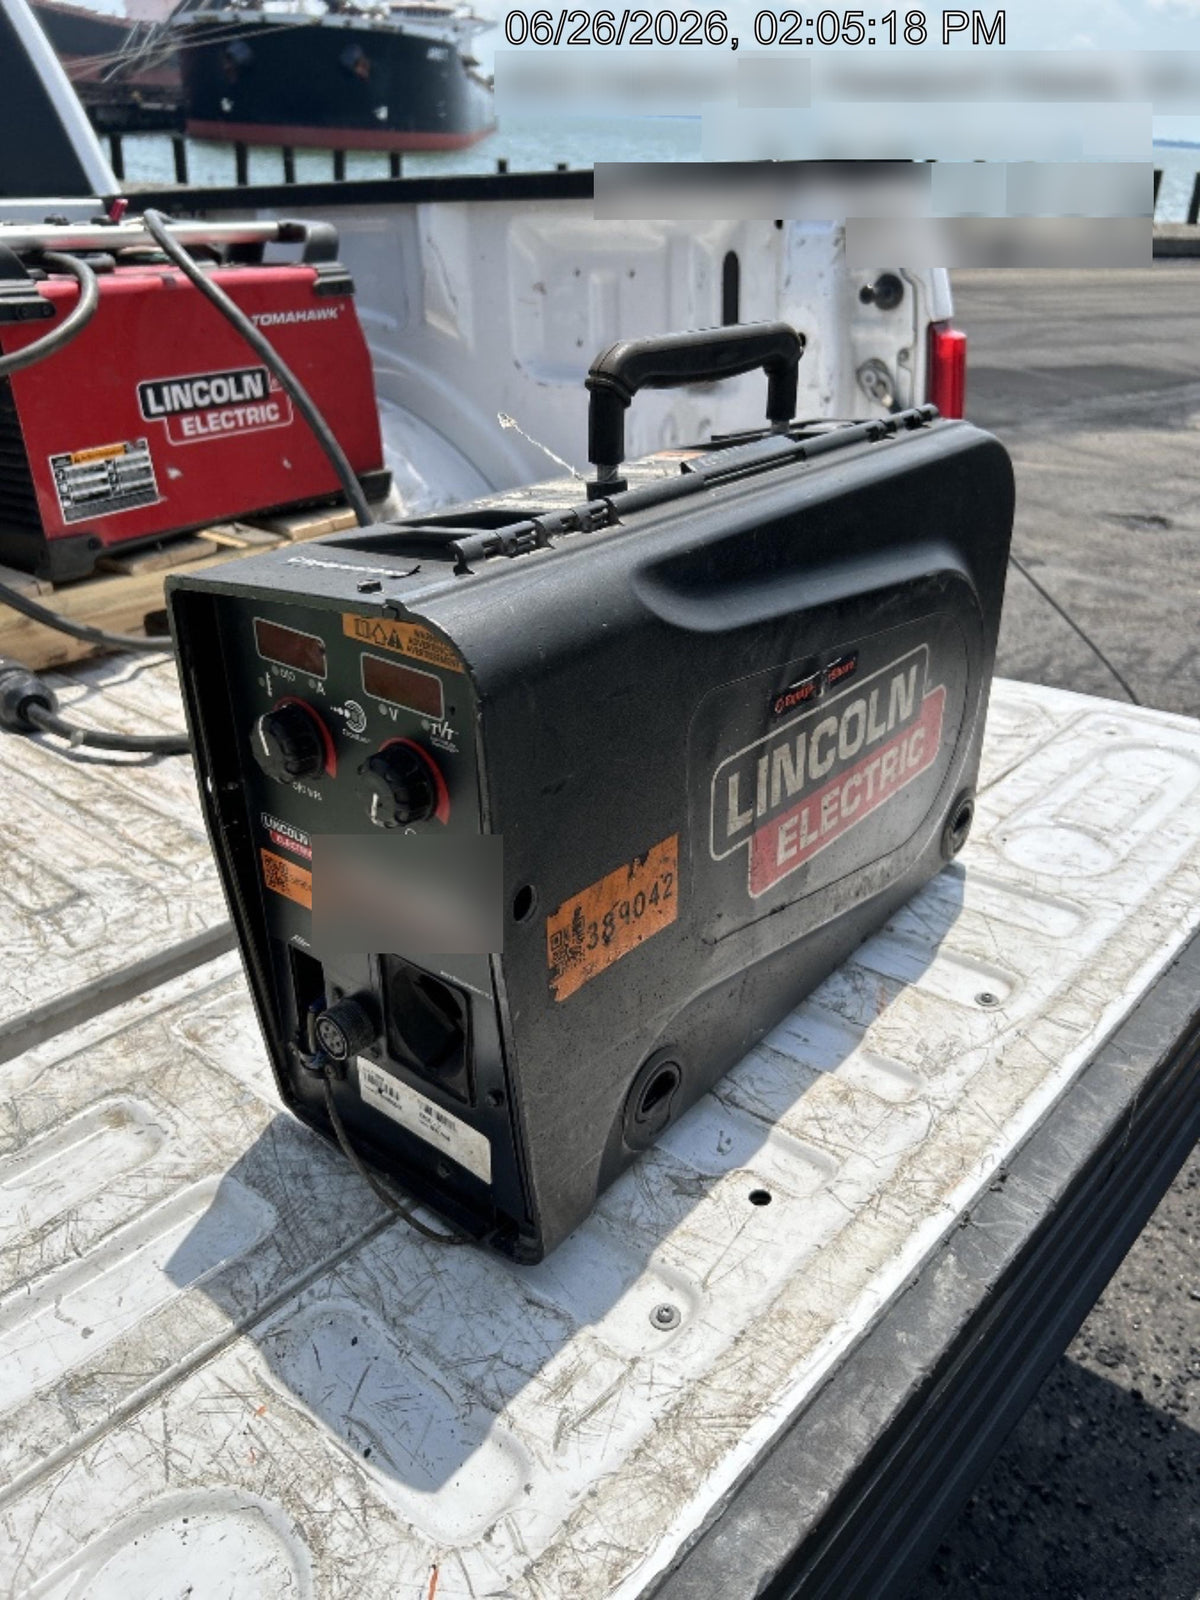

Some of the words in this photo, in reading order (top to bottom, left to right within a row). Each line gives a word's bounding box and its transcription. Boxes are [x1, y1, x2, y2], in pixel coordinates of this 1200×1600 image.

[251, 307, 338, 326] TOMAHAWK
[146, 373, 264, 414] LINCOLN
[181, 402, 280, 436] ELECTRIC
[727, 664, 918, 837] LINCOLN
[777, 727, 925, 867] ELECTRIC
[586, 872, 674, 950] 389042
